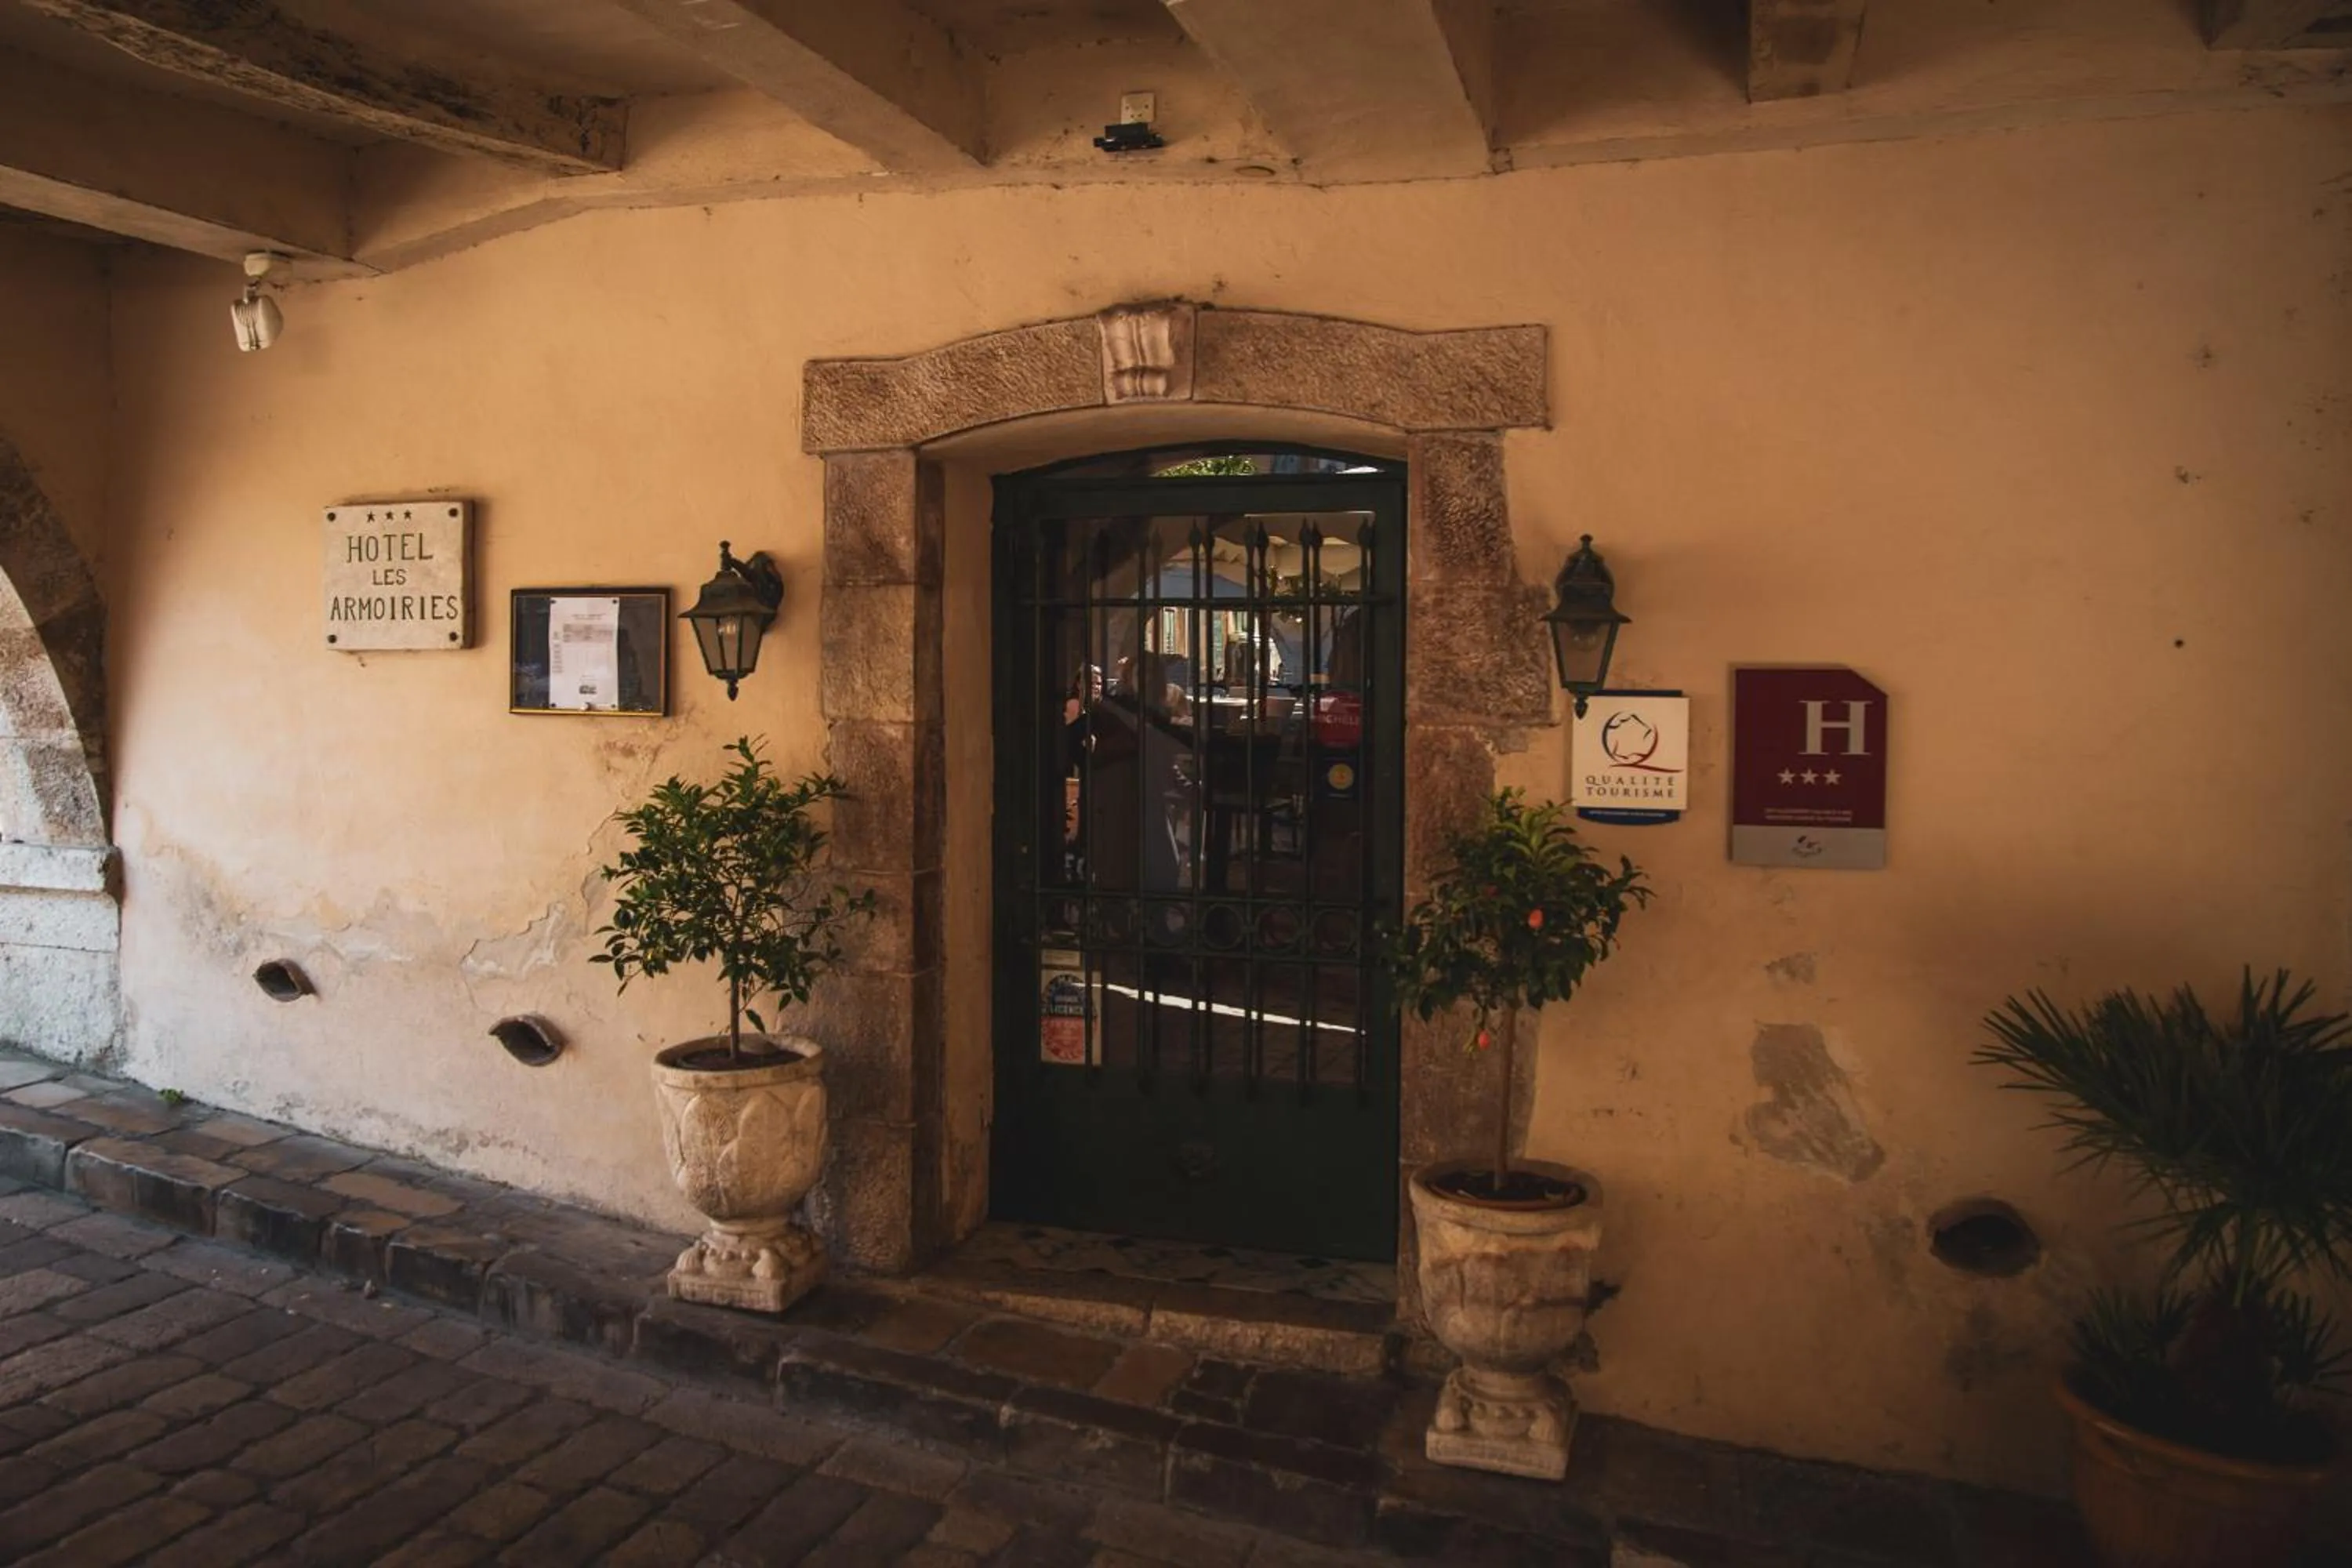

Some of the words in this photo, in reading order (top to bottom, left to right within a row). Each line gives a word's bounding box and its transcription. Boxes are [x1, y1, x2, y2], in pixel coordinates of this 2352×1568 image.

[347, 533, 434, 564] HOTEL
[372, 568, 407, 586] LES
[329, 595, 459, 622] ARMOIRIES
[1798, 700, 1874, 756] H
[1585, 786, 1675, 798] TOURISME
